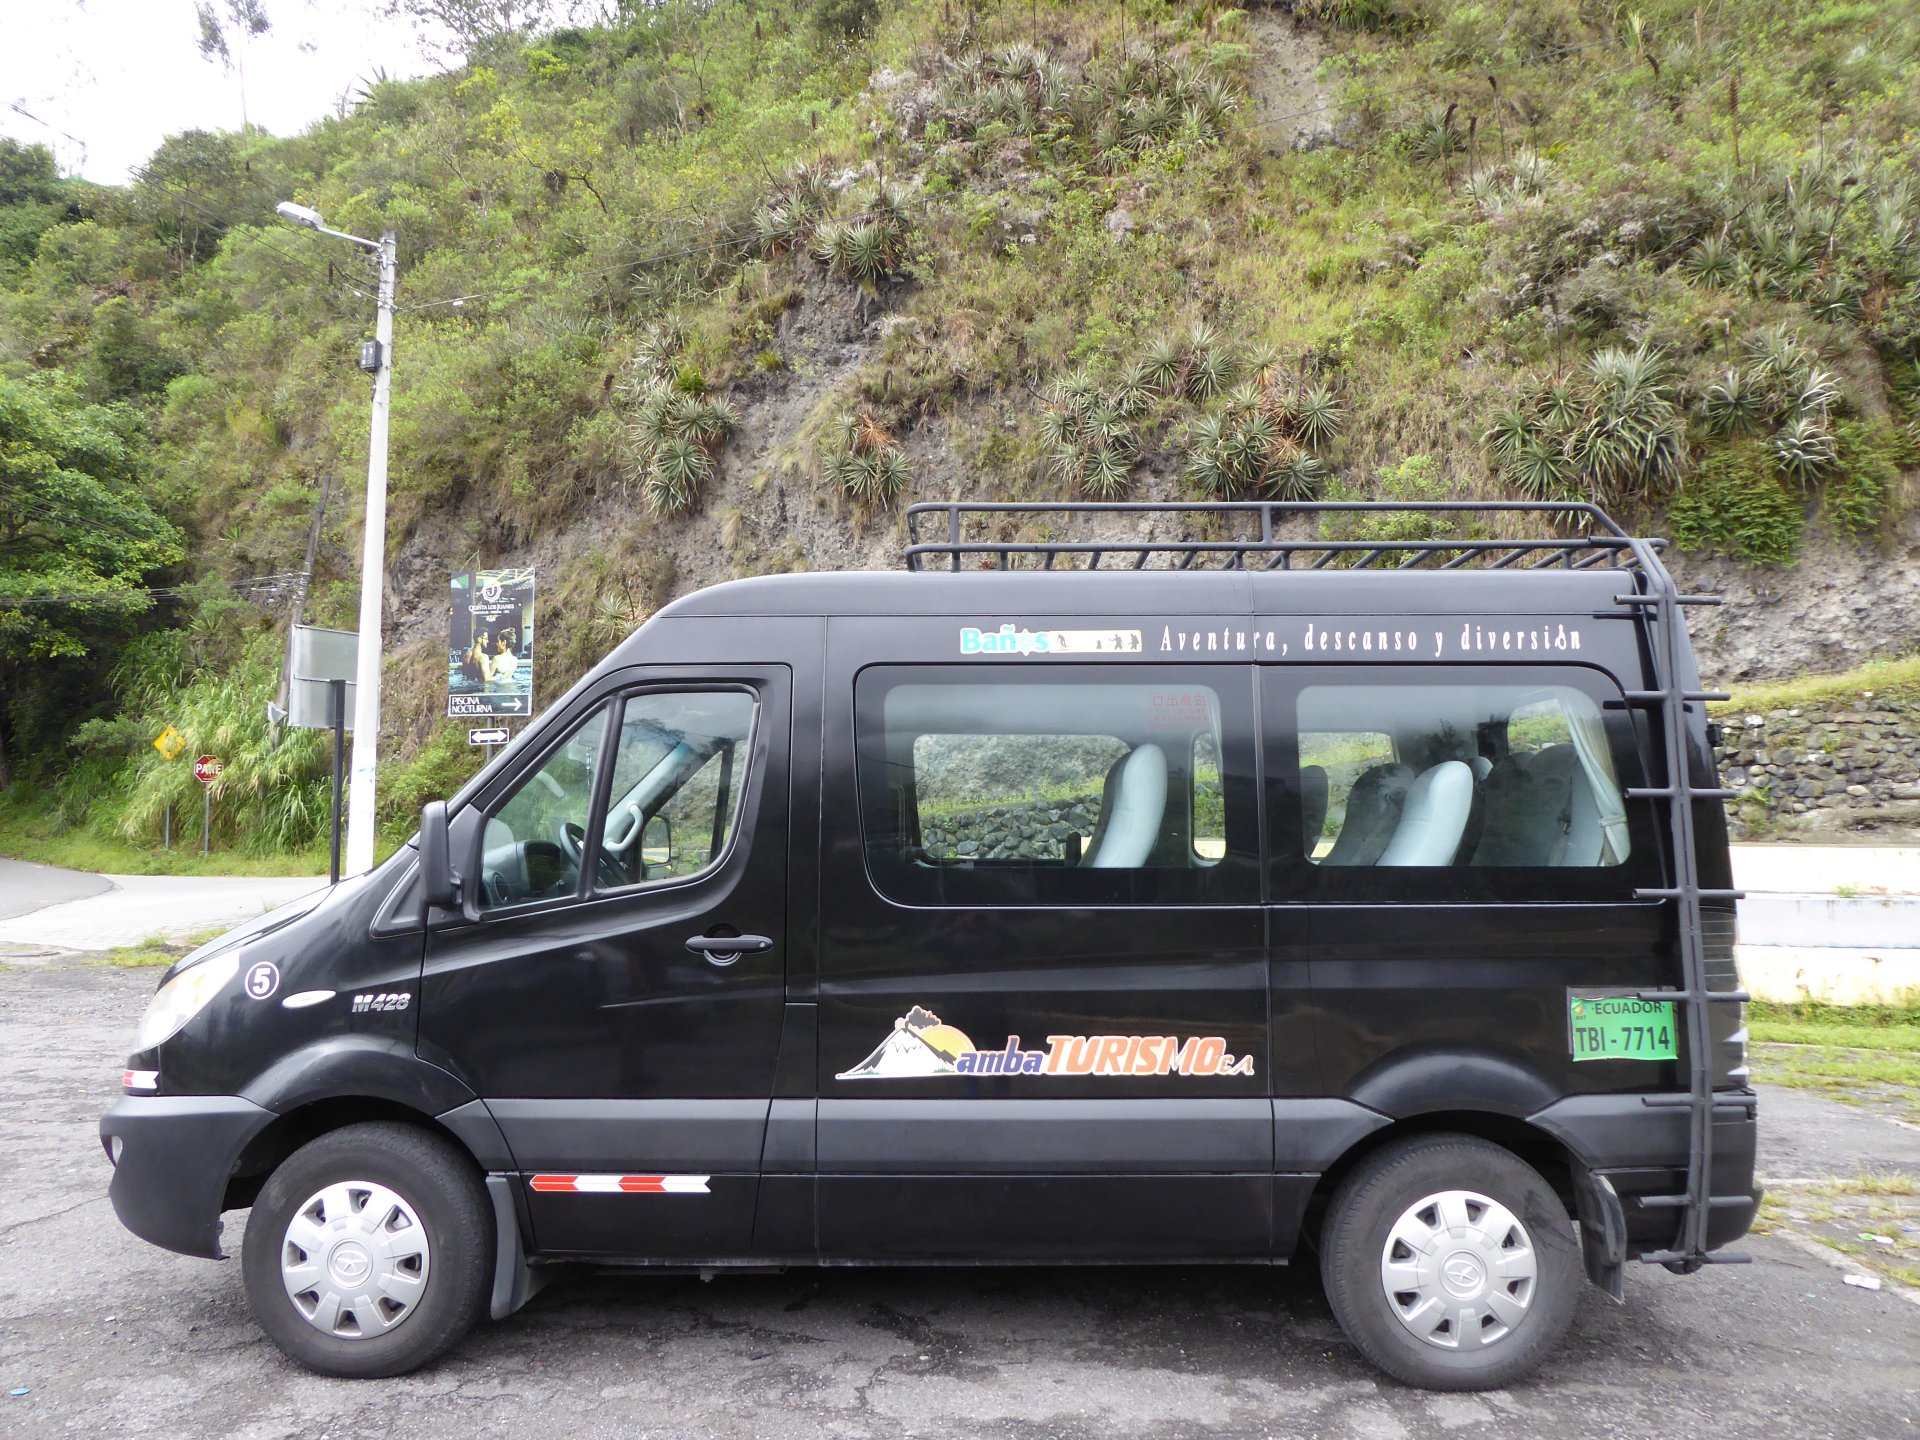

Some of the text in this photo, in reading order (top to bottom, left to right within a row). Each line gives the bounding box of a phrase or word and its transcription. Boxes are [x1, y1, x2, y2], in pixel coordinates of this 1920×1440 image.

[1160, 623, 1581, 658] Aventura, descanso y diversión
[452, 697, 480, 705] PISCINA
[452, 705, 493, 713] NOCTURNA
[253, 967, 271, 995] 5
[352, 993, 411, 1013] M428
[1595, 1001, 1663, 1015] ECUADOR
